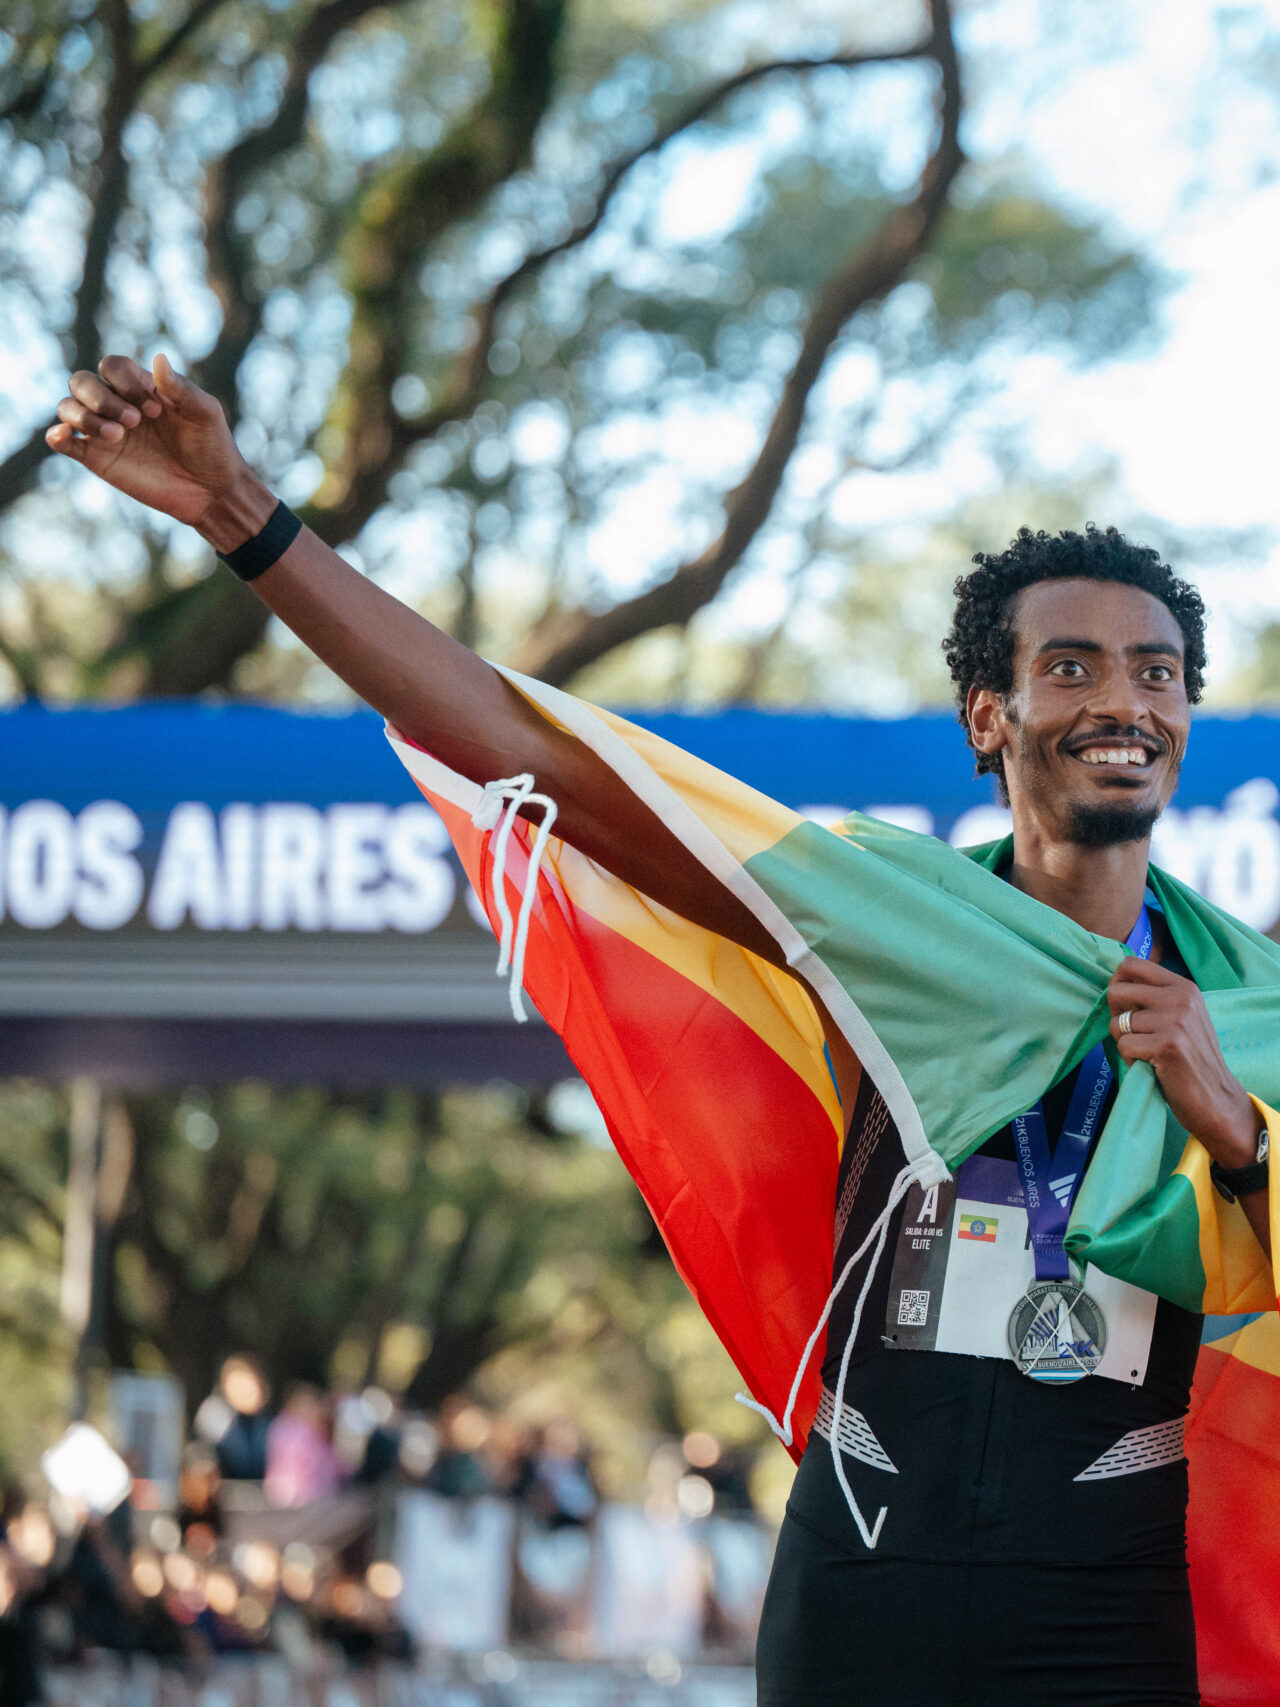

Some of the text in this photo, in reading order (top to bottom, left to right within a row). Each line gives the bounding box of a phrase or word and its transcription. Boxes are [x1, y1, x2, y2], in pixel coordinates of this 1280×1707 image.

[0, 799, 145, 930] OS
[147, 801, 456, 932] AIRES
[1026, 1179, 1040, 1208] AIRES
[916, 1184, 940, 1224] A
[936, 1228, 944, 1237] HS
[912, 1239, 931, 1250] ELITE
[1057, 1285, 1080, 1297] BUENO
[1059, 1340, 1094, 1358] 21K
